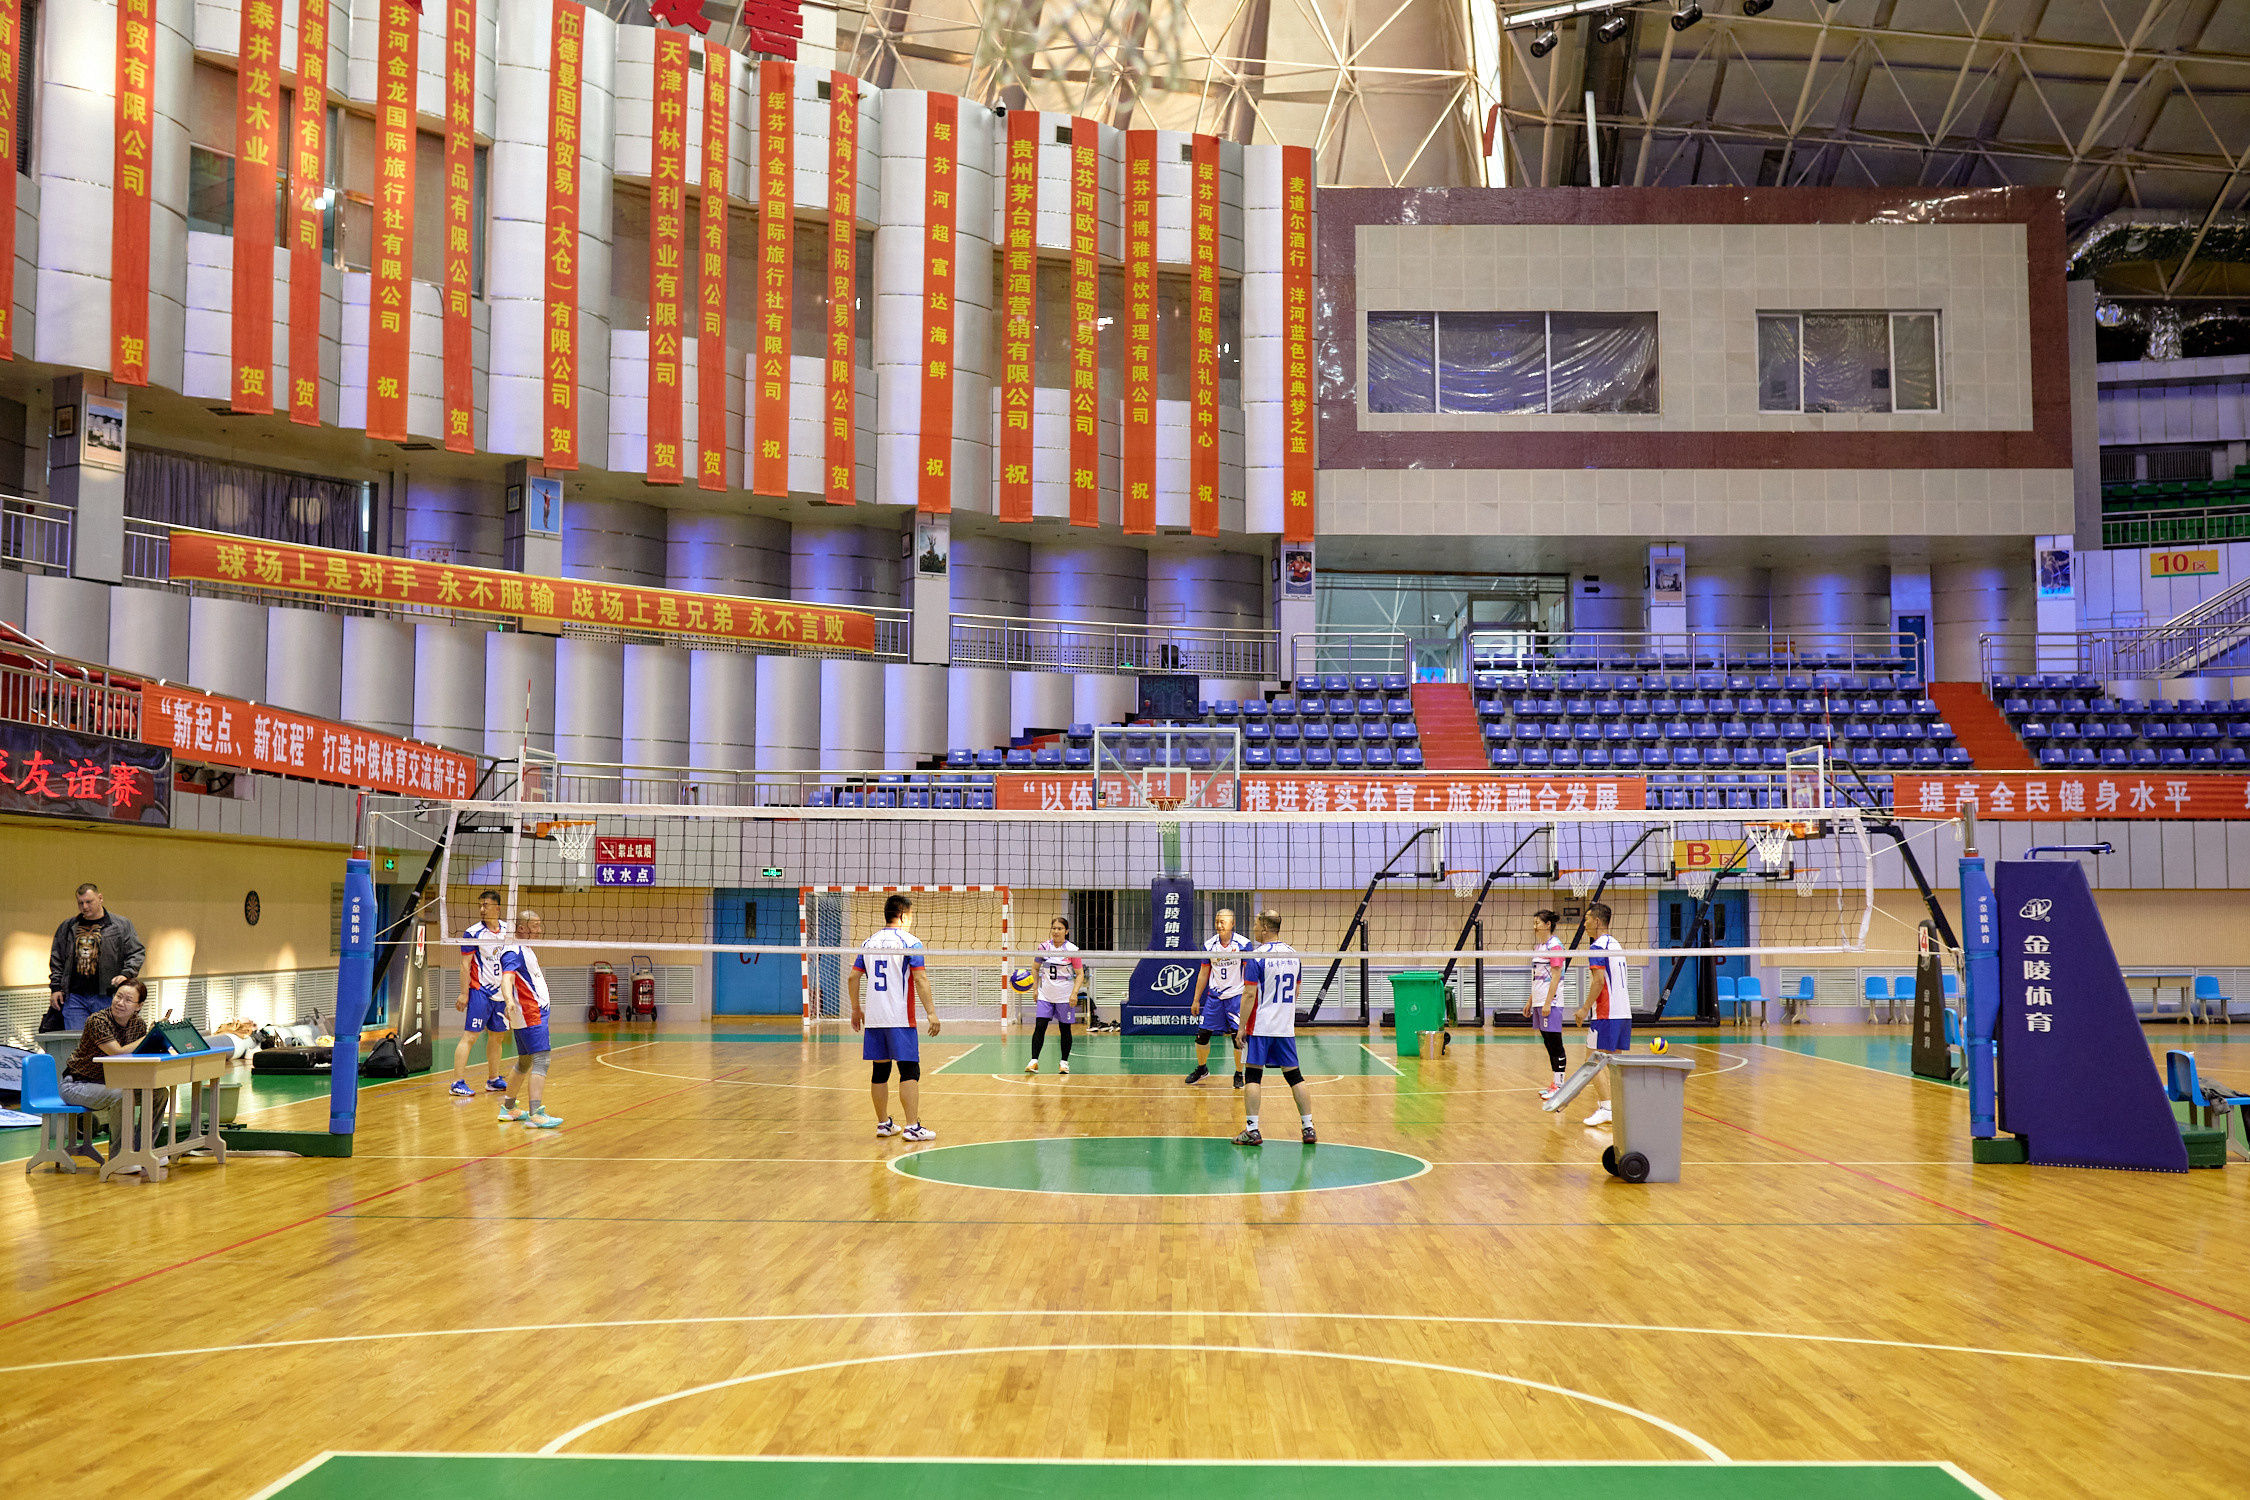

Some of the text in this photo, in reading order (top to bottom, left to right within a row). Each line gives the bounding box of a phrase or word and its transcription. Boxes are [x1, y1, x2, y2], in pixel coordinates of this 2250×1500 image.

[450, 0, 471, 436] 口中林林产品有限公司 贺
[654, 40, 683, 469] 天津中林天利实业有限公司 贺
[703, 52, 727, 476] 青海三佳商贸有限公司 贺
[762, 91, 787, 460] 绥芬河金龙国际旅行社有限公司 祝
[831, 83, 854, 490] 太仓海之源国际贸易有限公司 贺
[926, 122, 952, 477] 绥芬河超富达海鲜 祝
[1004, 139, 1034, 485] 贵州茅台酱香酒营销有限公司 祝
[1074, 146, 1096, 490] 绥芬河欧亚凯盛贸易有限公司 祝
[1131, 159, 1151, 500] 绥芬河博雅餐饮管理有限公司 祝
[1197, 163, 1214, 503] 绥芬河数码港酒店婚庆礼仪中心 祝
[121, 334, 144, 367] 贺
[240, 366, 265, 396] 贺
[296, 377, 315, 408] 贺
[377, 376, 399, 399] 祝
[550, 426, 572, 454] 贺
[1290, 489, 1308, 507] 祝
[217, 544, 846, 644] 球场上是对手 永不服输 战场上是兄弟 永不言败
[1919, 779, 2191, 813] 提高全民健身水平
[618, 843, 652, 858] 禁止吸烟
[602, 867, 649, 883] 饮水点
[351, 904, 360, 944] 金陵体育
[1164, 892, 1180, 948] 金陵体育
[1979, 904, 1990, 944] 金陵体育
[874, 960, 888, 992] 5
[1049, 965, 1057, 980] 9
[1220, 968, 1227, 980] 9
[1272, 973, 1295, 1004] 12
[2023, 935, 2053, 1033] 金陵体育
[471, 1018, 483, 1028] 24
[1543, 1018, 1548, 1028] 6
